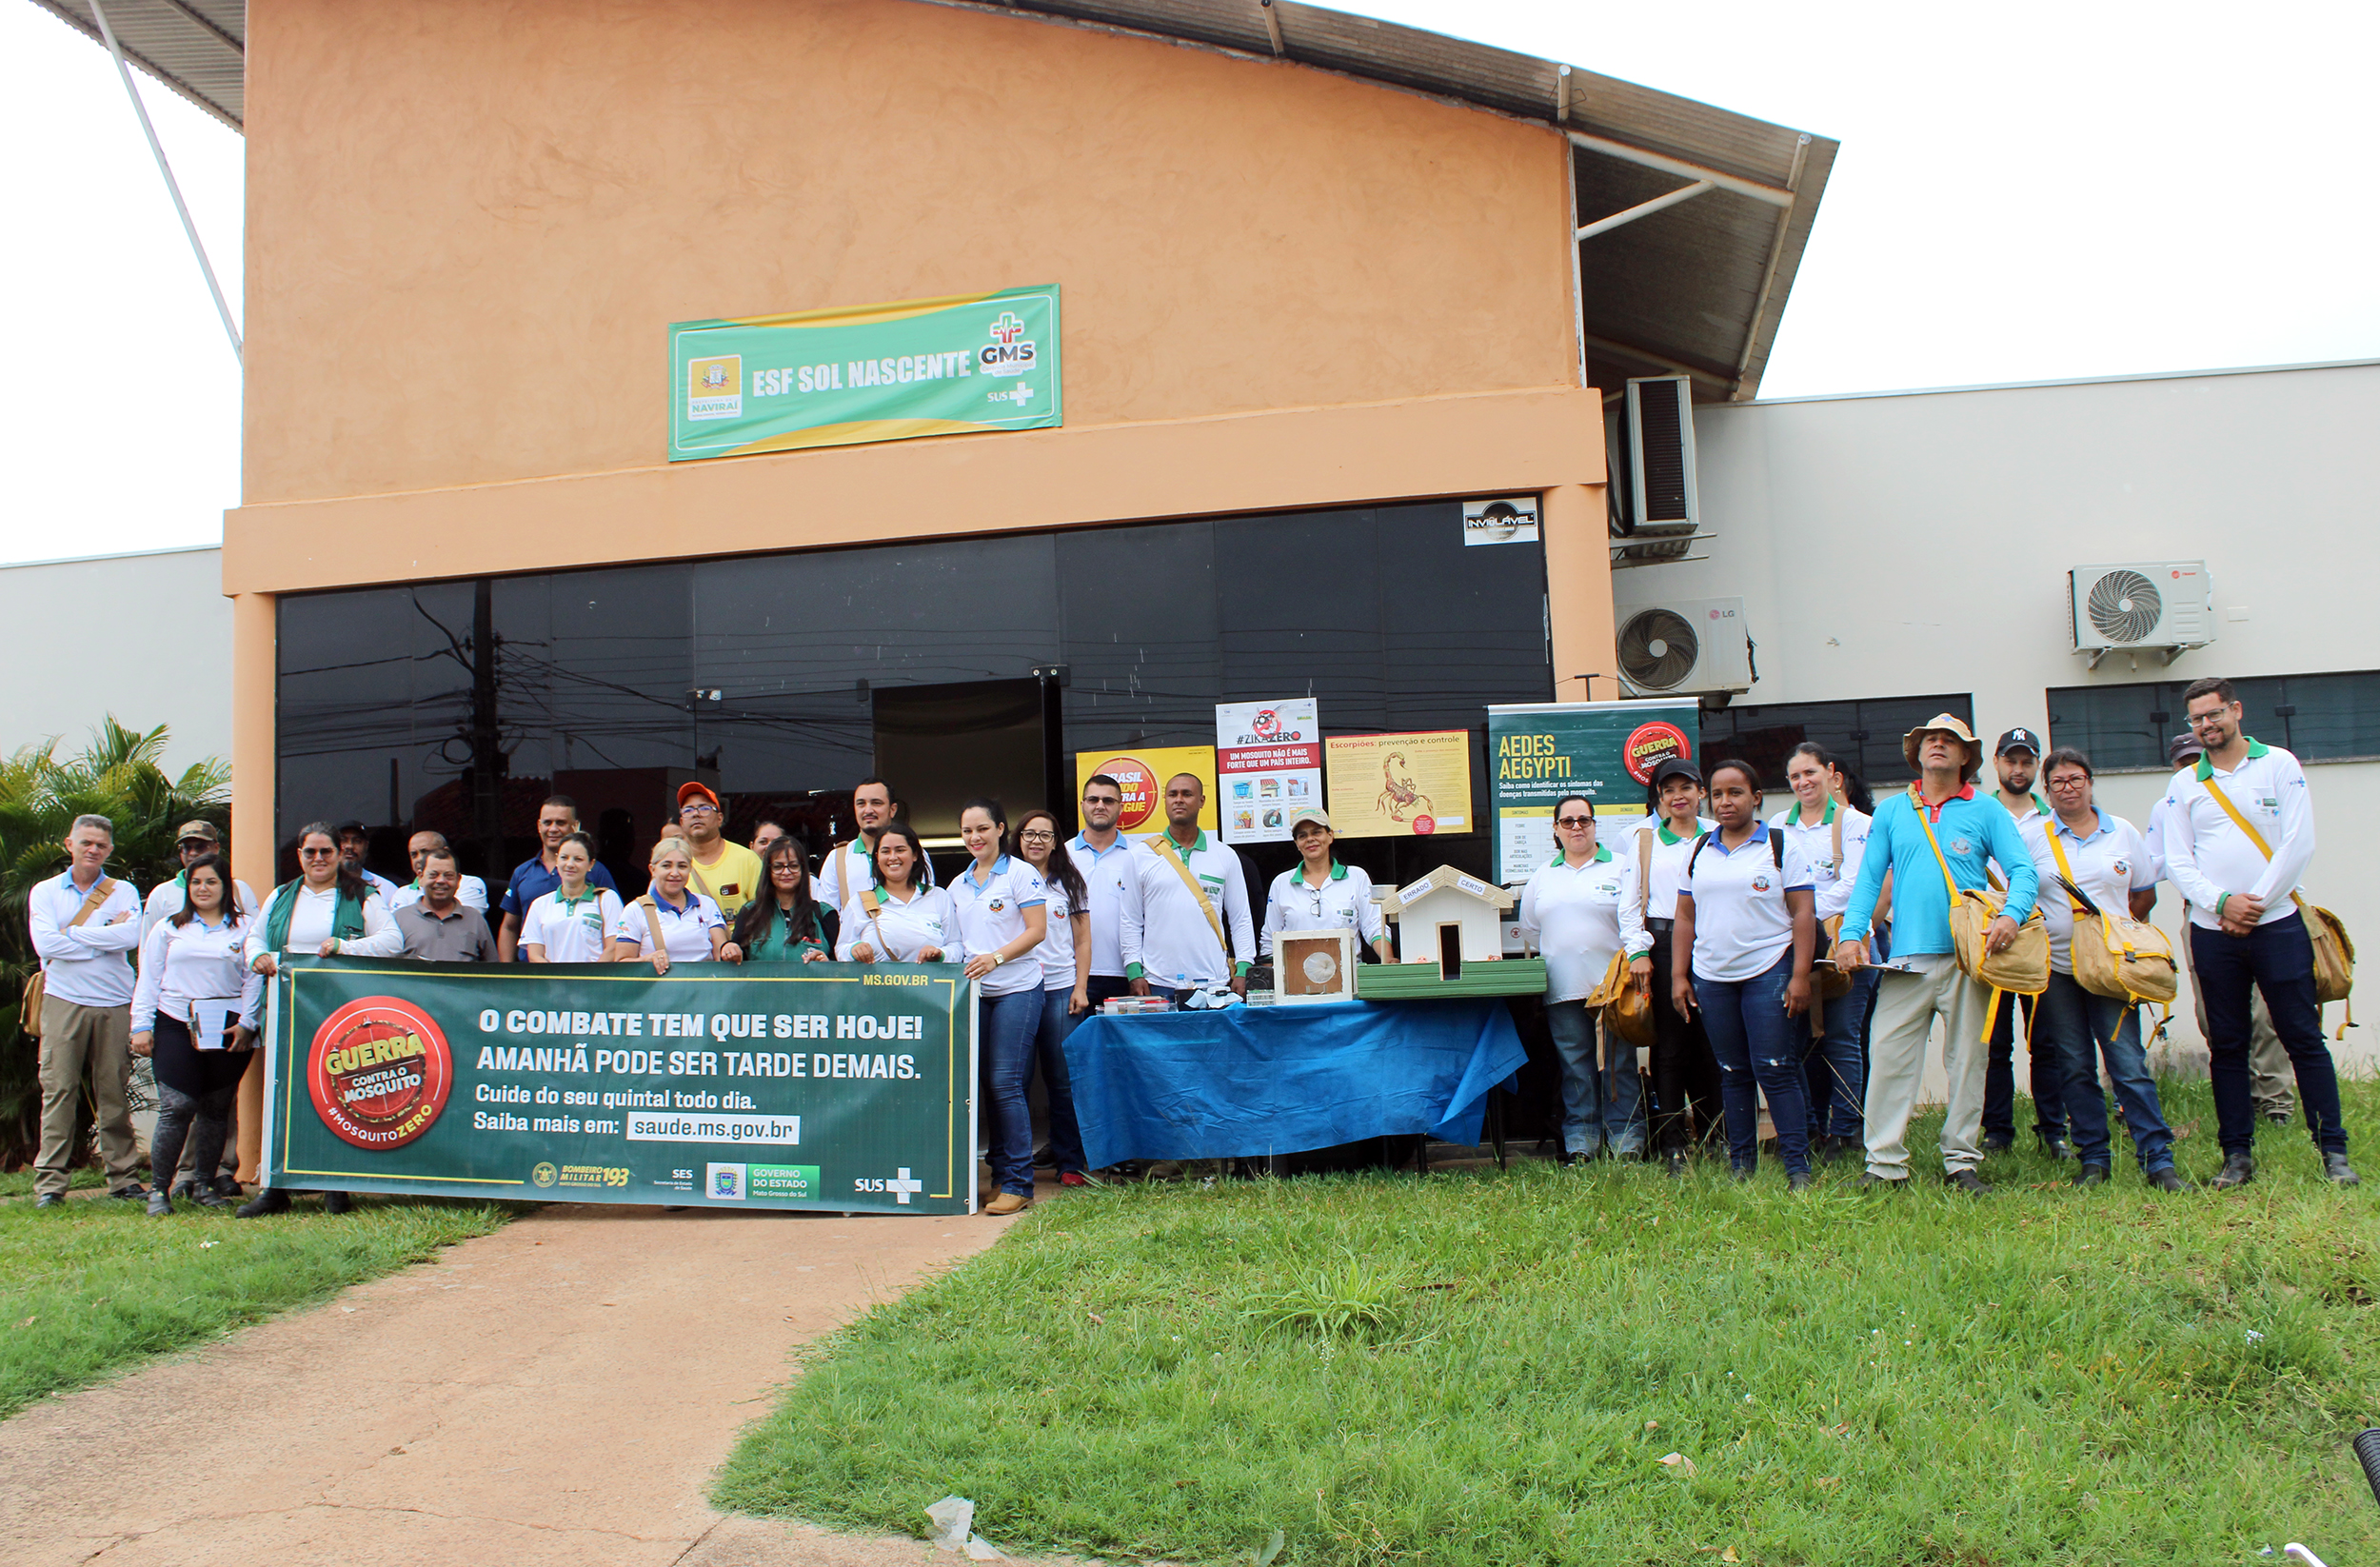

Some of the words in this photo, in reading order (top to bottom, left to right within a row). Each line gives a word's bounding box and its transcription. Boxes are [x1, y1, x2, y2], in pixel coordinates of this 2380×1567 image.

[982, 344, 1033, 364] GMS
[753, 367, 793, 397] ESF
[798, 363, 843, 393] SOL
[848, 349, 971, 388] NASCENTE
[987, 391, 1008, 402] SUS
[692, 400, 737, 412] NAVIRAÍ
[1237, 731, 1301, 744] #ZIKAZERO
[1379, 738, 1418, 747] prevenção
[1498, 734, 1556, 757] AEDES
[1631, 737, 1678, 757] GUERRA
[1241, 750, 1272, 759] MOSQUITO
[1273, 748, 1285, 757] NÃO
[1287, 748, 1291, 756] É
[1645, 752, 1665, 762] CONTRA
[1271, 757, 1284, 766] PAÍS
[1285, 757, 1311, 765] INTEIRO.
[1499, 756, 1571, 779] AEGYPTI
[1137, 792, 1146, 801] A
[1557, 789, 1569, 797] pelo
[1123, 802, 1146, 812] GUE
[1403, 882, 1429, 900] ERRADO
[1461, 879, 1483, 892] CERTO
[863, 974, 928, 986] MS.GOV.BR
[479, 1009, 500, 1032] O
[506, 1010, 643, 1036] COMBATE
[649, 1013, 704, 1037] TEM
[711, 1014, 767, 1042] QUE
[774, 1014, 829, 1039] SER
[836, 1015, 923, 1040] HOJE!
[325, 1034, 426, 1075] GUERRA
[477, 1042, 589, 1073] AMANHÃ
[595, 1049, 663, 1074] PODE
[669, 1051, 718, 1075] SER
[723, 1052, 807, 1077] TARDE
[813, 1053, 921, 1079] DEMAIS.
[352, 1070, 397, 1087] CONTRA
[398, 1067, 407, 1076] O
[344, 1074, 422, 1103] MOSQUITO
[476, 1083, 531, 1103] Cuide
[535, 1086, 559, 1104] do
[564, 1091, 598, 1105] seu
[603, 1089, 669, 1109] quintal
[675, 1091, 717, 1108] todo
[722, 1091, 757, 1110] dia.
[474, 1111, 529, 1131] Saiba
[533, 1115, 580, 1134] mais
[584, 1118, 619, 1135] em:
[635, 1118, 793, 1140] saude.ms.gov.br
[560, 1173, 602, 1181] MILITAR
[562, 1165, 603, 1173] BOMBEIRO
[602, 1168, 630, 1187] 193
[672, 1169, 693, 1179] SES
[753, 1169, 800, 1178] GOVERNO
[753, 1179, 768, 1187] DO
[769, 1179, 807, 1188] ESTADO
[854, 1178, 884, 1192] SUS
